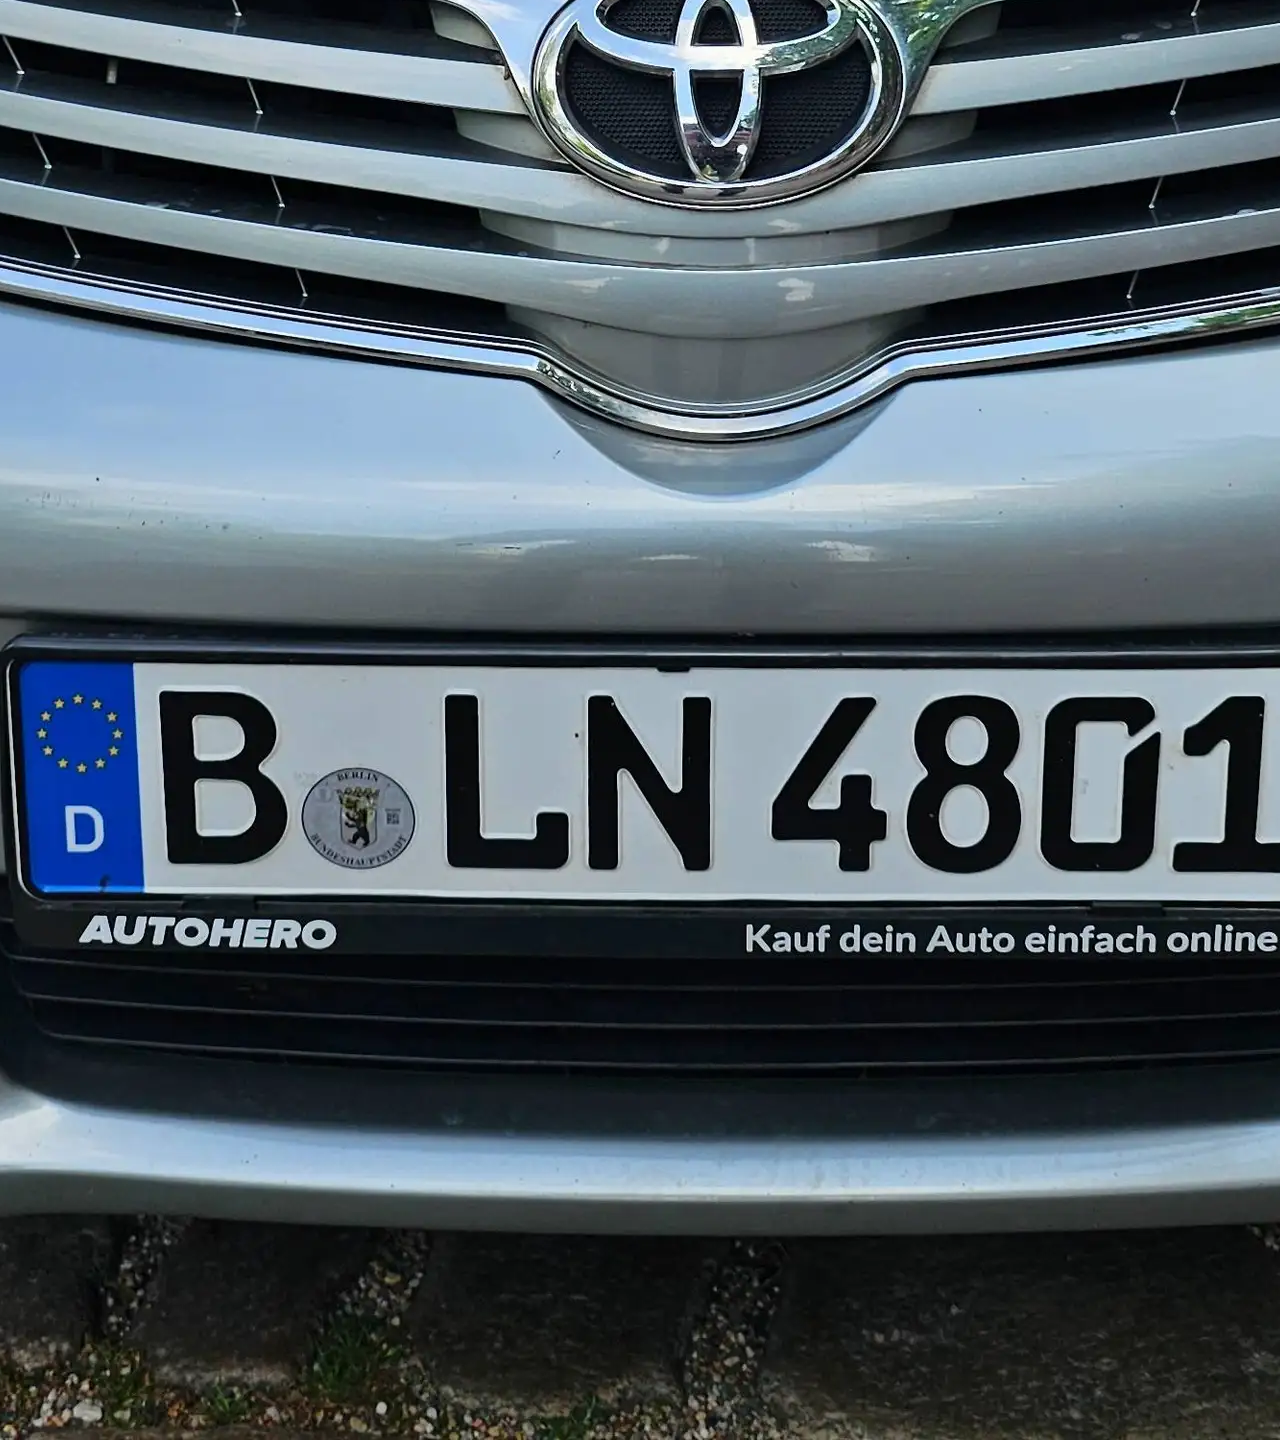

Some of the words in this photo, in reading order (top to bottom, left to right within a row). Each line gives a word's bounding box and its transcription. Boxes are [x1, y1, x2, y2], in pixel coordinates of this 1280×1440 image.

[158, 690, 288, 864] B
[444, 695, 712, 870] LN
[336, 771, 380, 782] BERLIN
[65, 805, 105, 853] D
[310, 832, 407, 866] BUNDESHAUPTSTADT
[79, 915, 337, 950] AUTOHERO
[745, 925, 829, 952] Kauf
[839, 925, 915, 952] dein
[926, 926, 1015, 952] Auto
[1024, 925, 1157, 953] einfach
[1166, 925, 1278, 953] online
